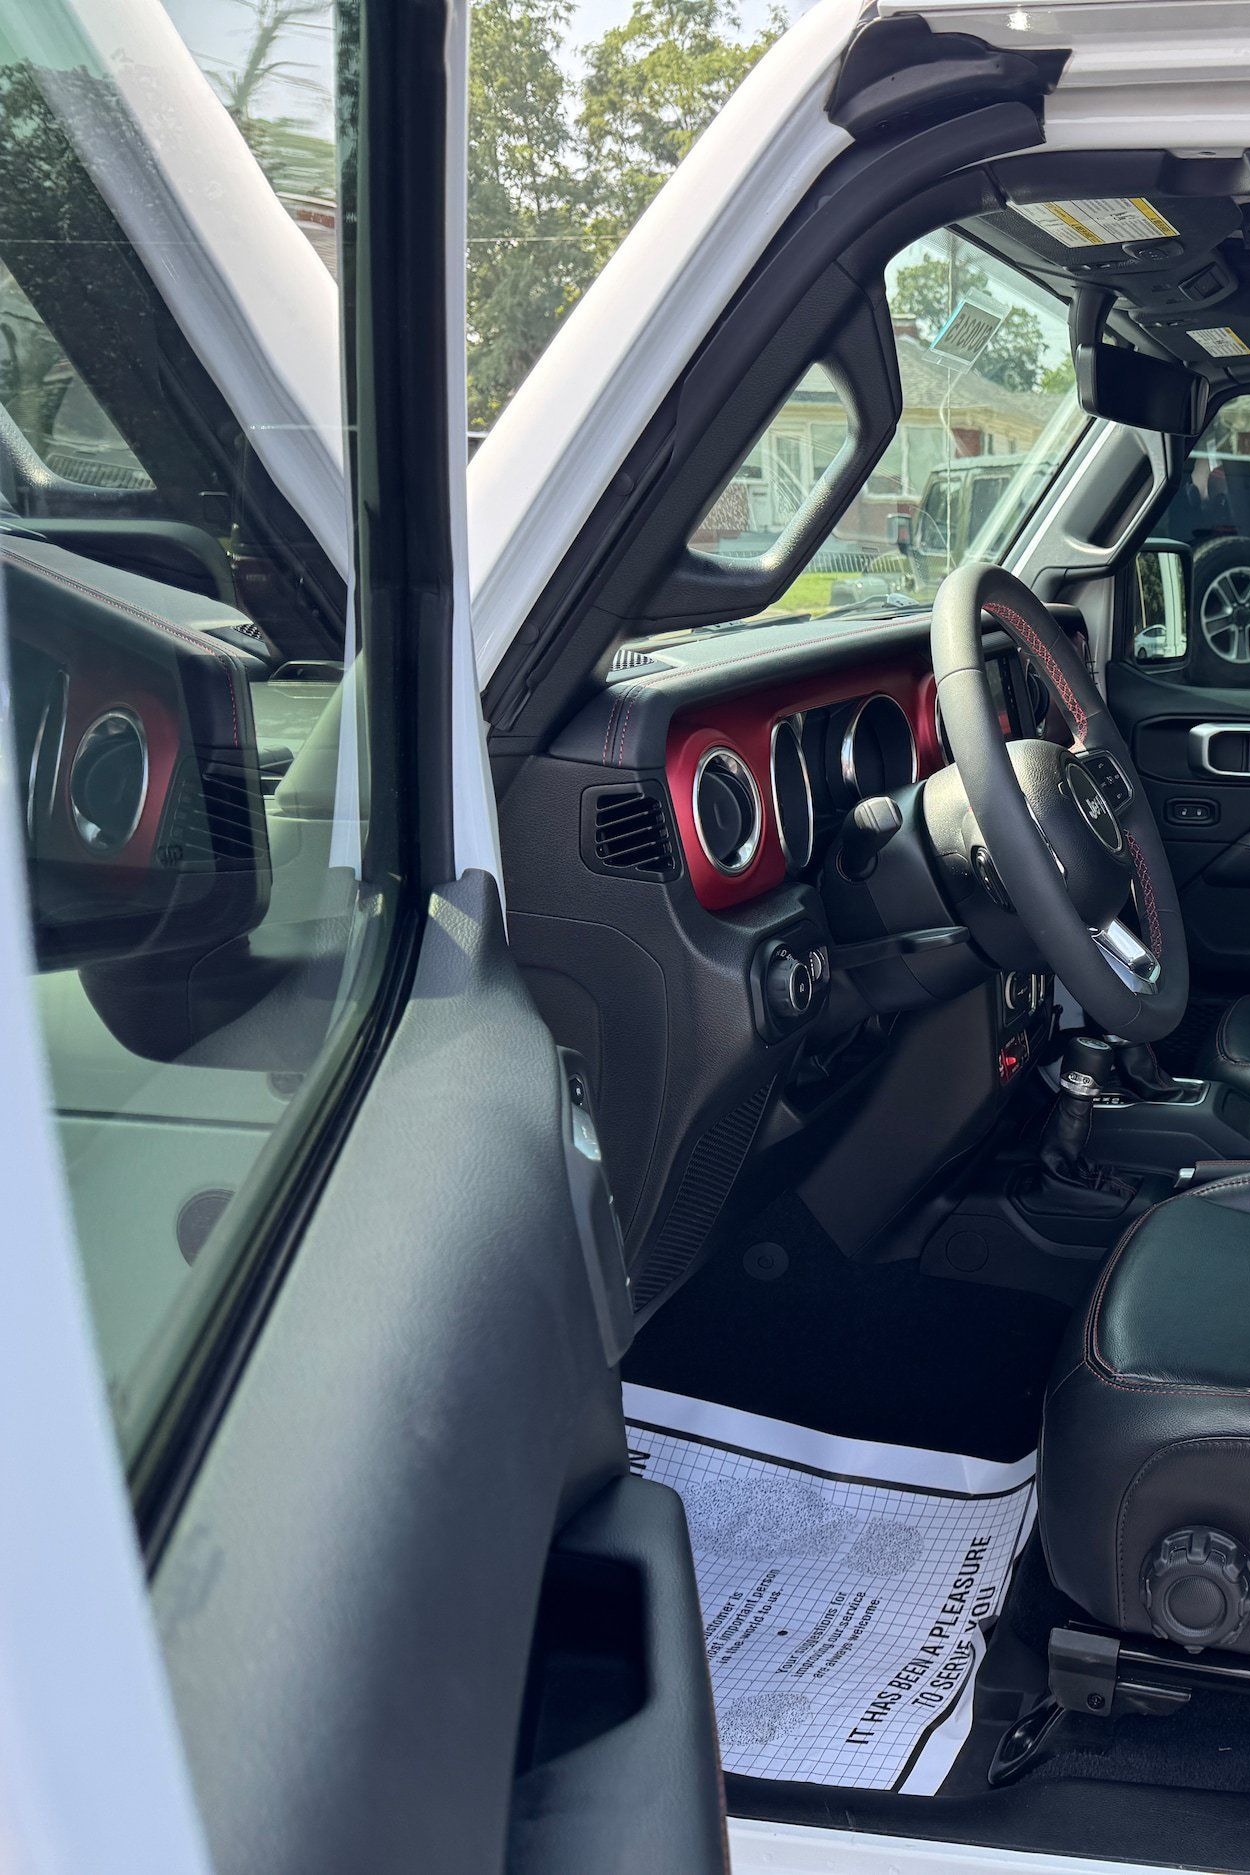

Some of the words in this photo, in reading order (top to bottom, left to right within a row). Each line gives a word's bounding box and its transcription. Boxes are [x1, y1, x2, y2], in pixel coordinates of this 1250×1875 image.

[716, 1599, 757, 1642] important
[753, 1568, 781, 1599] person
[928, 1534, 992, 1639] PLEASURE
[716, 1655, 731, 1665] in
[725, 1640, 744, 1655] the
[740, 1615, 764, 1640] world
[760, 1603, 772, 1615] to
[770, 1588, 785, 1603] us.
[776, 1654, 799, 1674] Your
[795, 1607, 838, 1657] suggestions
[831, 1591, 847, 1606] for
[791, 1642, 834, 1678] improving
[828, 1624, 844, 1645] our
[840, 1591, 867, 1628] service
[813, 1664, 830, 1679] are
[826, 1642, 854, 1668] always
[851, 1596, 883, 1641] welcome.
[911, 1691, 945, 1708] TO
[930, 1639, 973, 1691] SERVE
[964, 1585, 997, 1633] YOU
[921, 1642, 945, 1657] A
[860, 1690, 903, 1723] HAS
[888, 1656, 930, 1691] BEEN
[845, 1727, 875, 1745] IT
